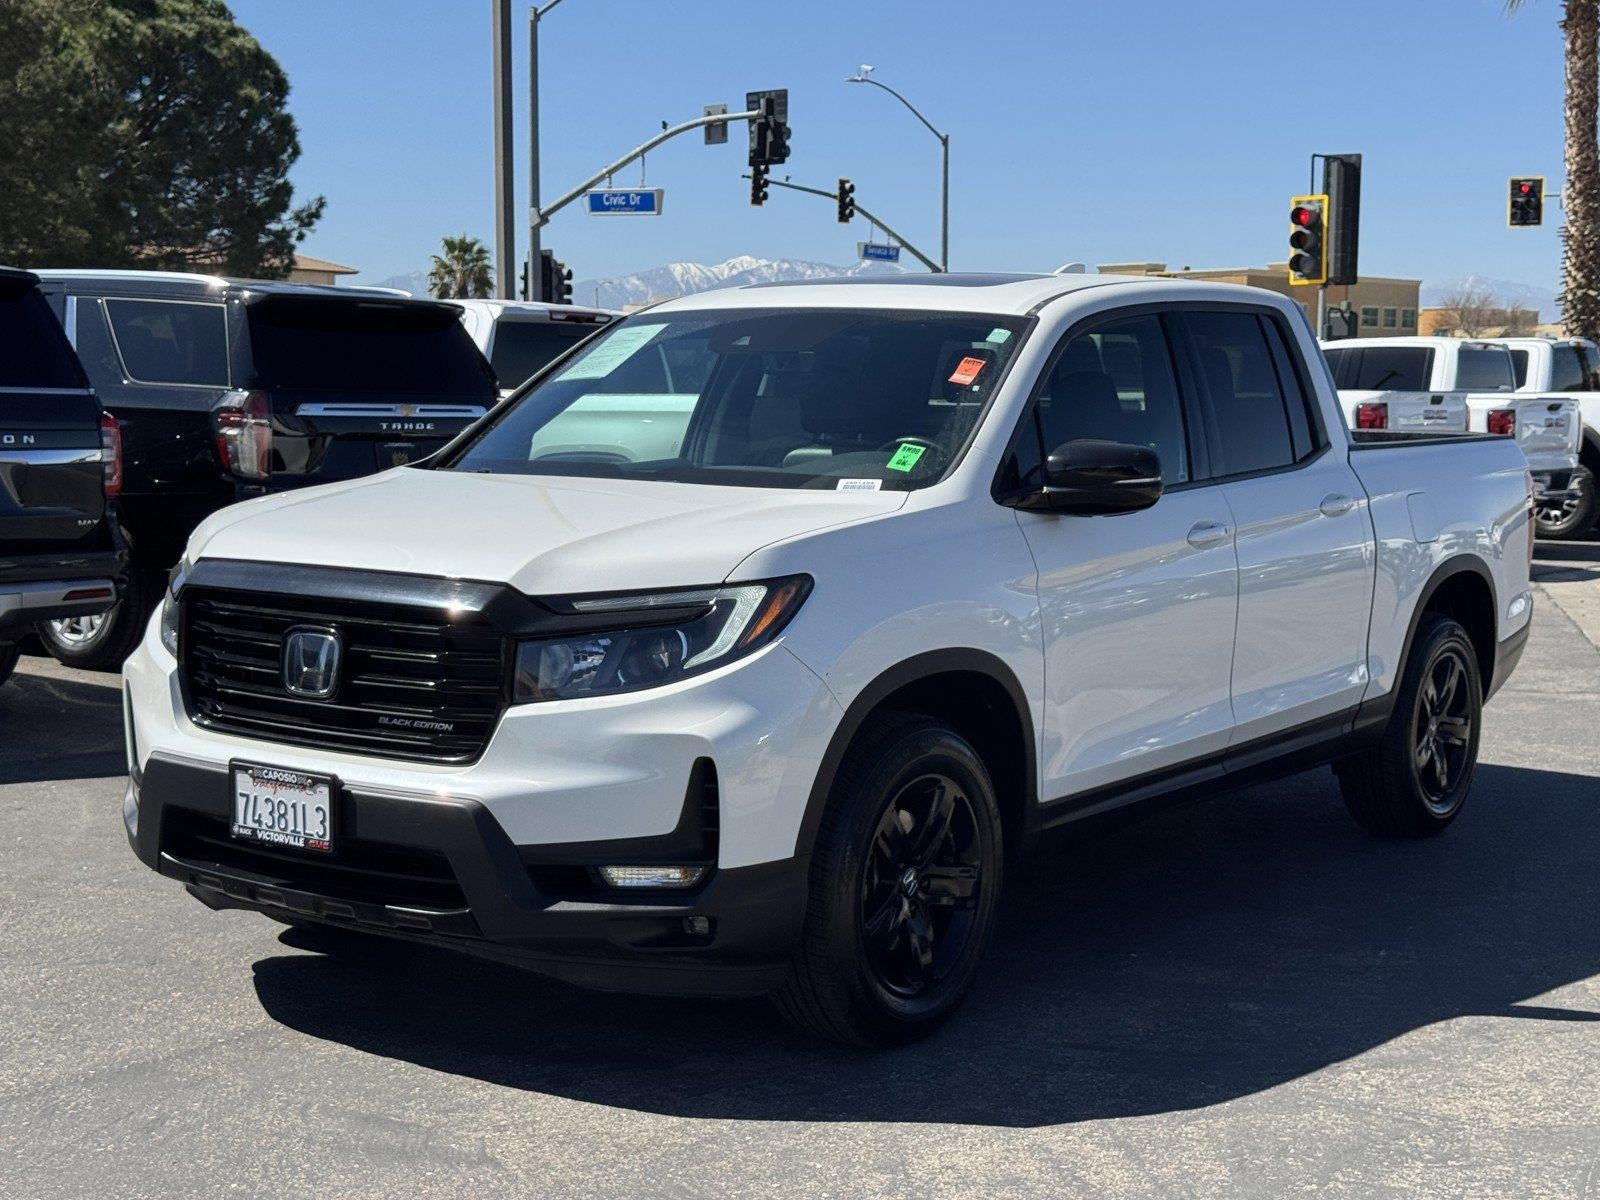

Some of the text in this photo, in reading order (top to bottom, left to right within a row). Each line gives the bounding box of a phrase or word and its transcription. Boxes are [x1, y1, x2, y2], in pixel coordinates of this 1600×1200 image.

[602, 193, 641, 206] Civic Dr
[380, 422, 435, 430] TAHOE
[901, 445, 921, 455] SMOG
[895, 459, 909, 467] OK
[378, 716, 454, 732] BLACK EDITION
[262, 769, 298, 784] CAPOSIO
[239, 792, 327, 840] 74381L3
[257, 829, 305, 848] VICTORVILLE
[309, 839, 330, 851] GMC
